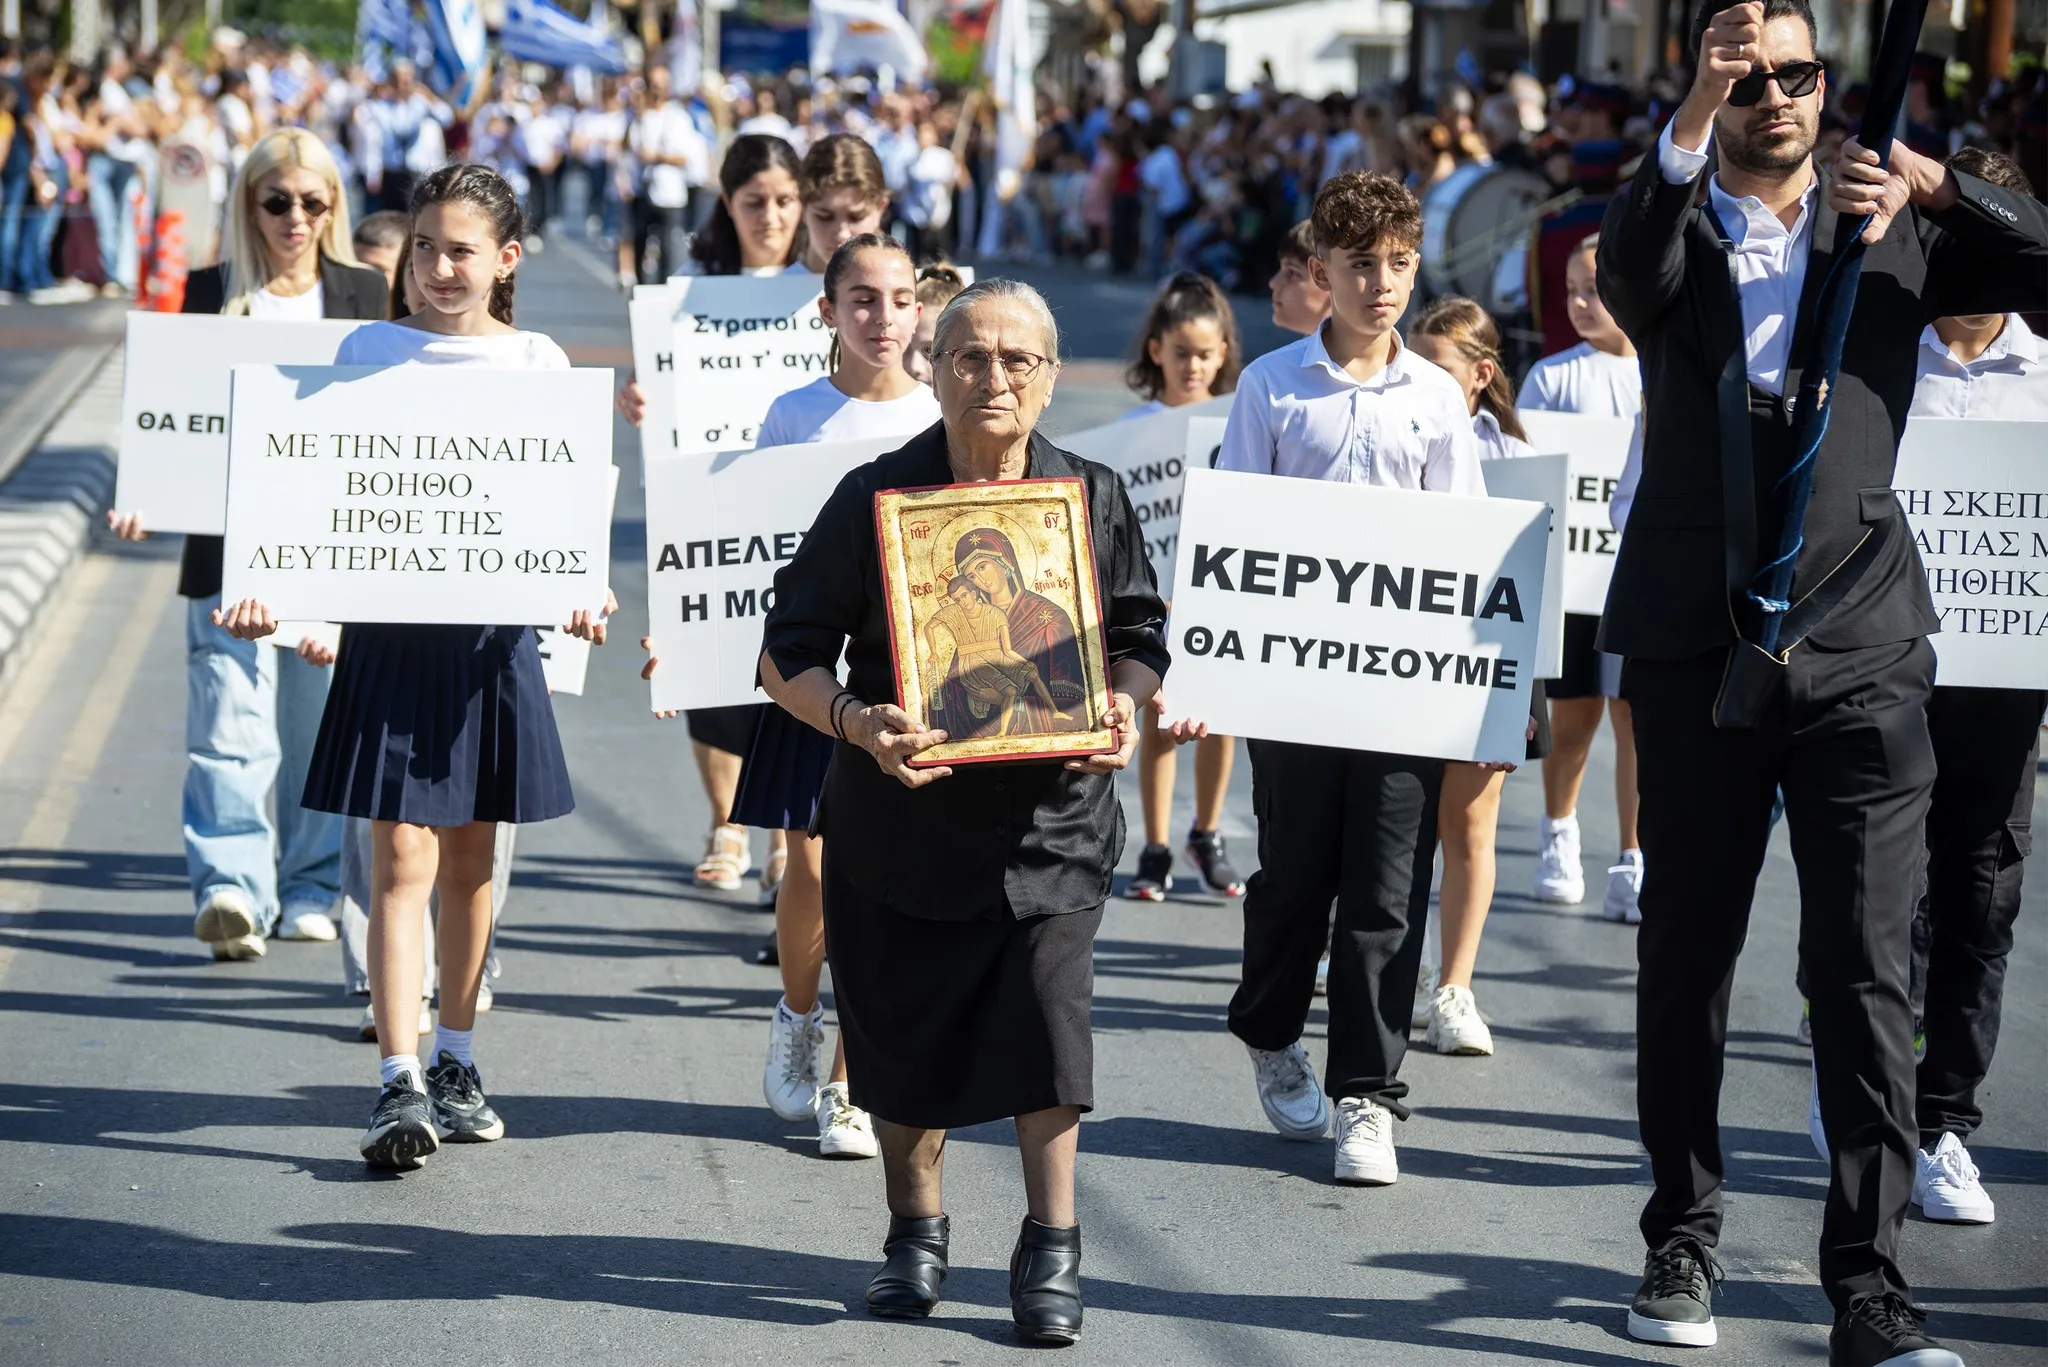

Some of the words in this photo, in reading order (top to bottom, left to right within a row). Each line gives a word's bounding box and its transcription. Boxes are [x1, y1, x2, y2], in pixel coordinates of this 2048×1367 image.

[700, 356, 741, 369] και
[137, 411, 177, 432] ΘΑ
[187, 414, 225, 434] ΕΠ
[266, 432, 319, 459] ΜΕ
[330, 434, 402, 460] ΤΗΝ
[414, 435, 576, 463] ΠΑΝΑΓΙΑ
[346, 472, 473, 498] ΒΟΗΘΟ
[1942, 490, 2048, 518] ΣΚΕΠ
[331, 508, 424, 534] ΗΡΘΕ
[435, 510, 504, 536] ΤΗΣ
[248, 545, 448, 573] ΛΕΥΤΕΡΙΑΣ
[457, 548, 504, 574] ΤΟ
[515, 550, 588, 574] ΦΩΣ
[1191, 544, 1525, 624] ΚΕΡΥΝΕΙΑ
[1926, 567, 2048, 597] ΗΘΗΚ
[681, 593, 708, 622] Η
[1183, 626, 1245, 661] ΘΑ
[1260, 633, 1519, 691] ΓΥΡΙΣΟΥΜΕ
